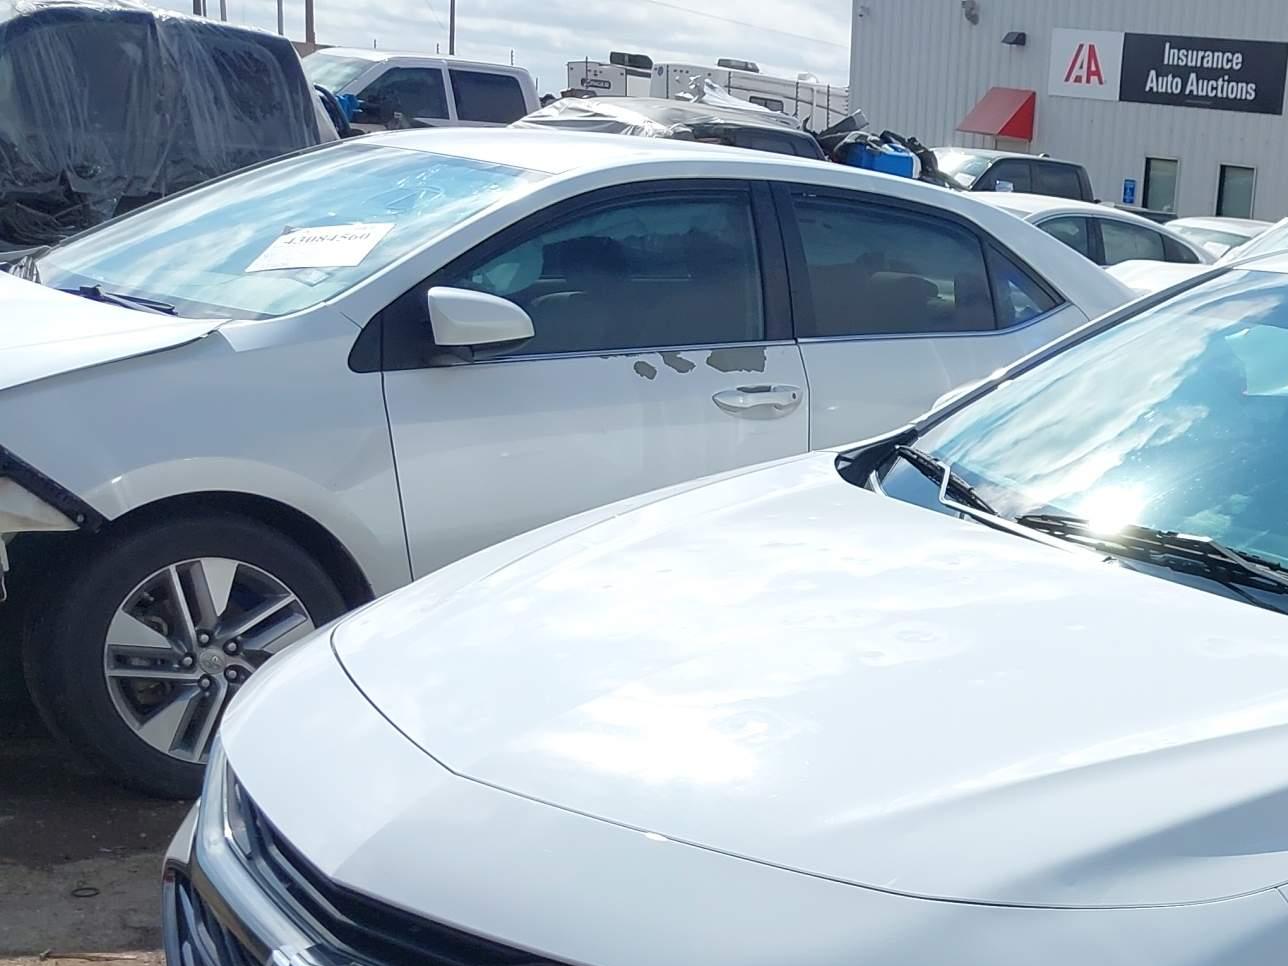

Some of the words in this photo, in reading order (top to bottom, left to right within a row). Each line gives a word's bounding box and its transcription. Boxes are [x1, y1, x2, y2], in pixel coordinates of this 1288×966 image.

[1163, 41, 1243, 70] Insurance
[1144, 69, 1182, 95] Auto
[1184, 72, 1256, 100] Auctions
